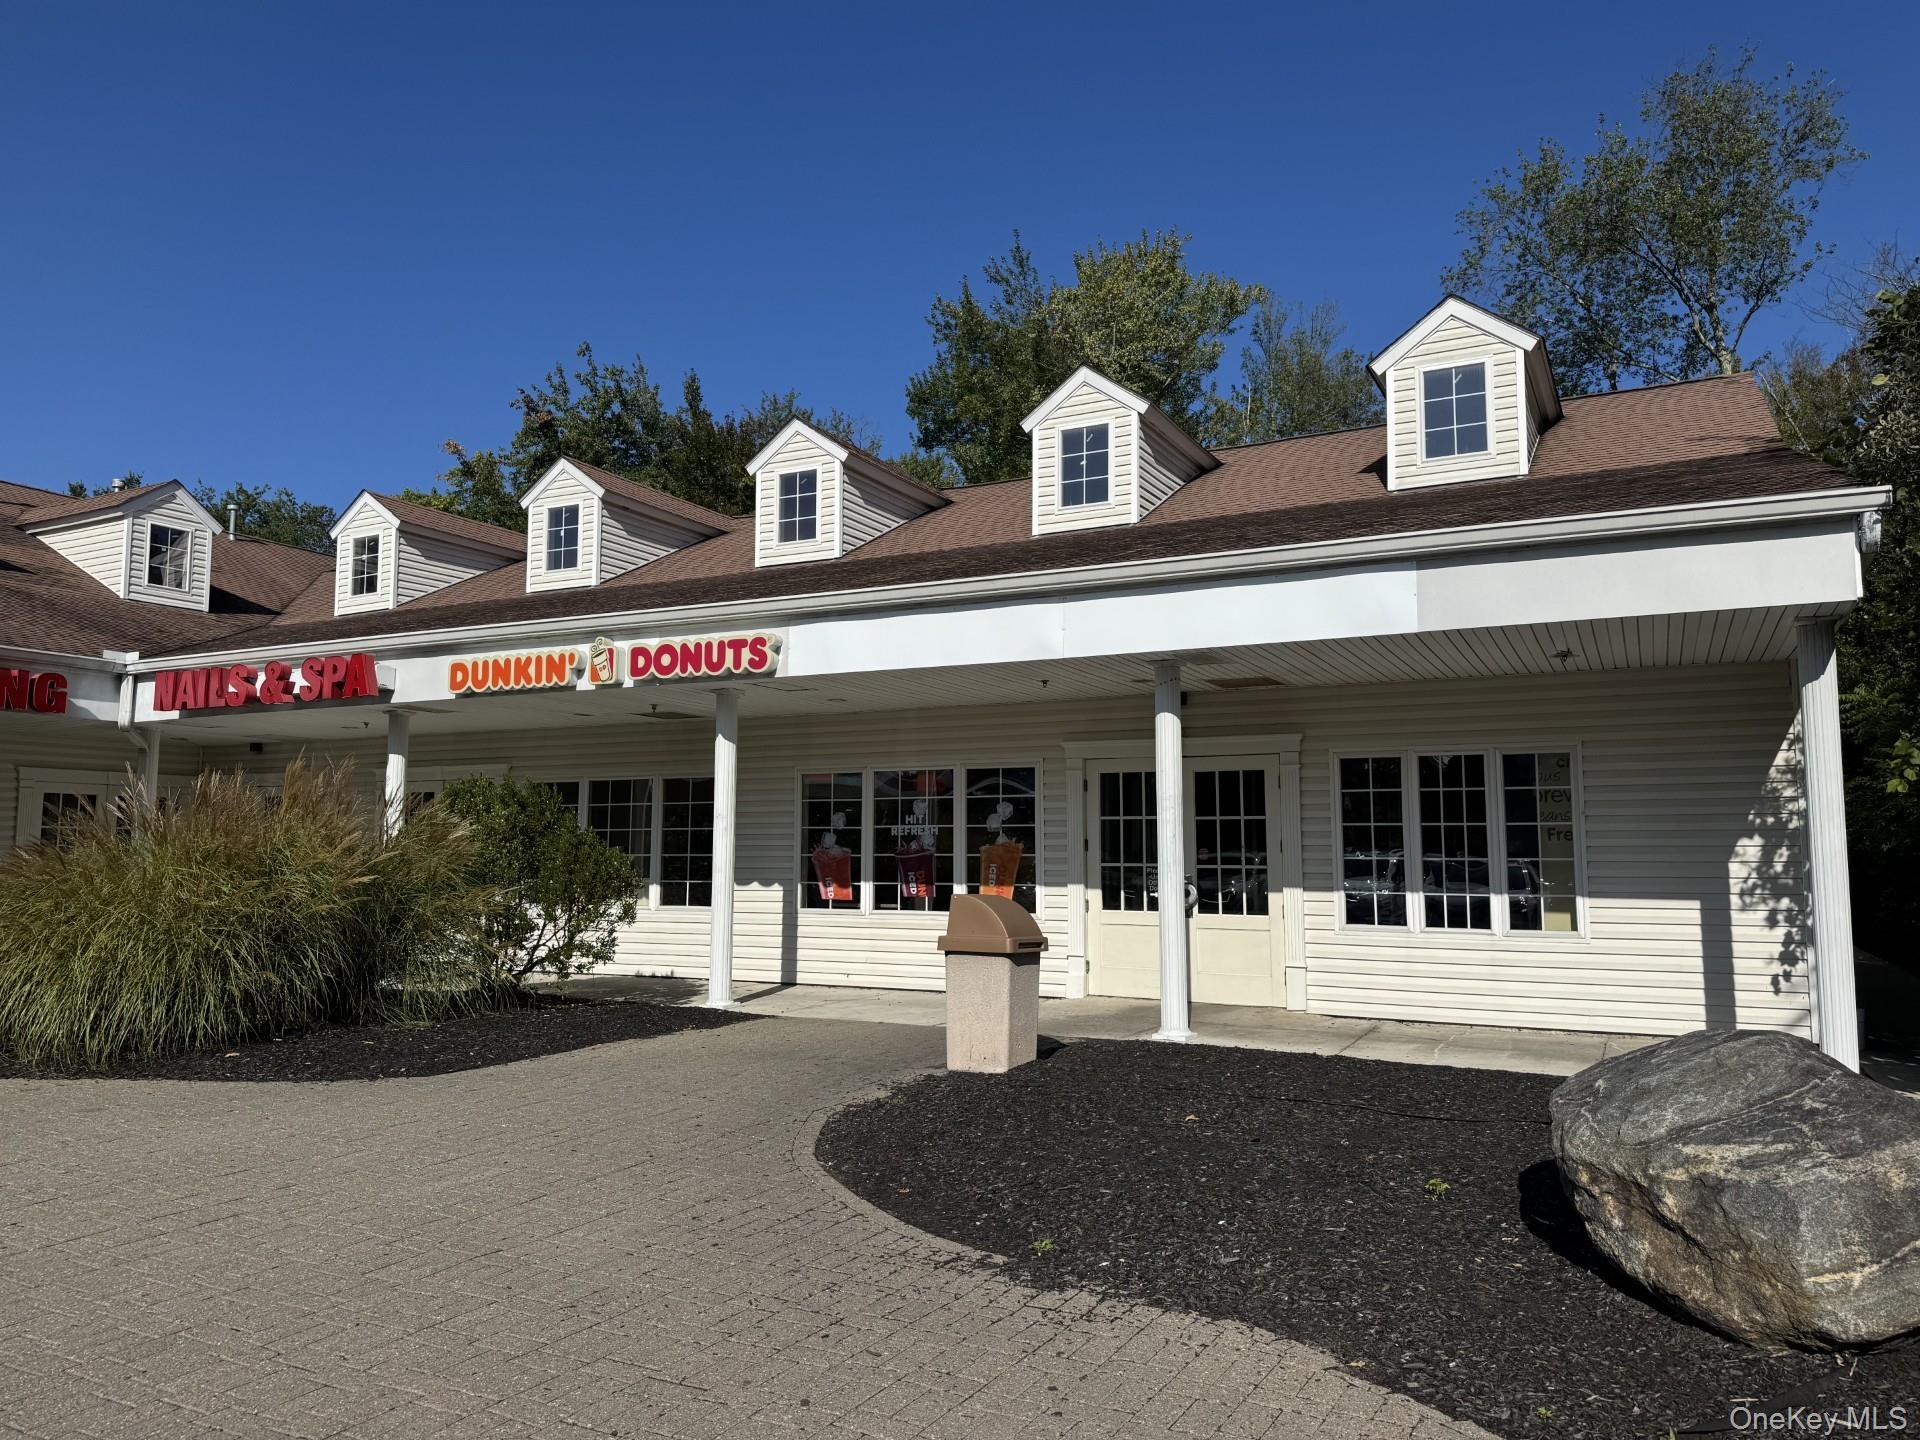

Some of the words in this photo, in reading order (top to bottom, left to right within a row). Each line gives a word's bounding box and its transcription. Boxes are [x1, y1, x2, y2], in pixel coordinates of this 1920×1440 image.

[450, 653, 576, 691] DUNKIN'
[630, 637, 768, 678] DONUTS
[154, 663, 252, 711] NAILS
[260, 660, 294, 704] &
[300, 653, 376, 702] SPA
[890, 826, 939, 836] REFRESH
[905, 814, 924, 824] HIT
[907, 871, 917, 895] ICED
[989, 863, 999, 887] ICED
[825, 877, 834, 898] ICED
